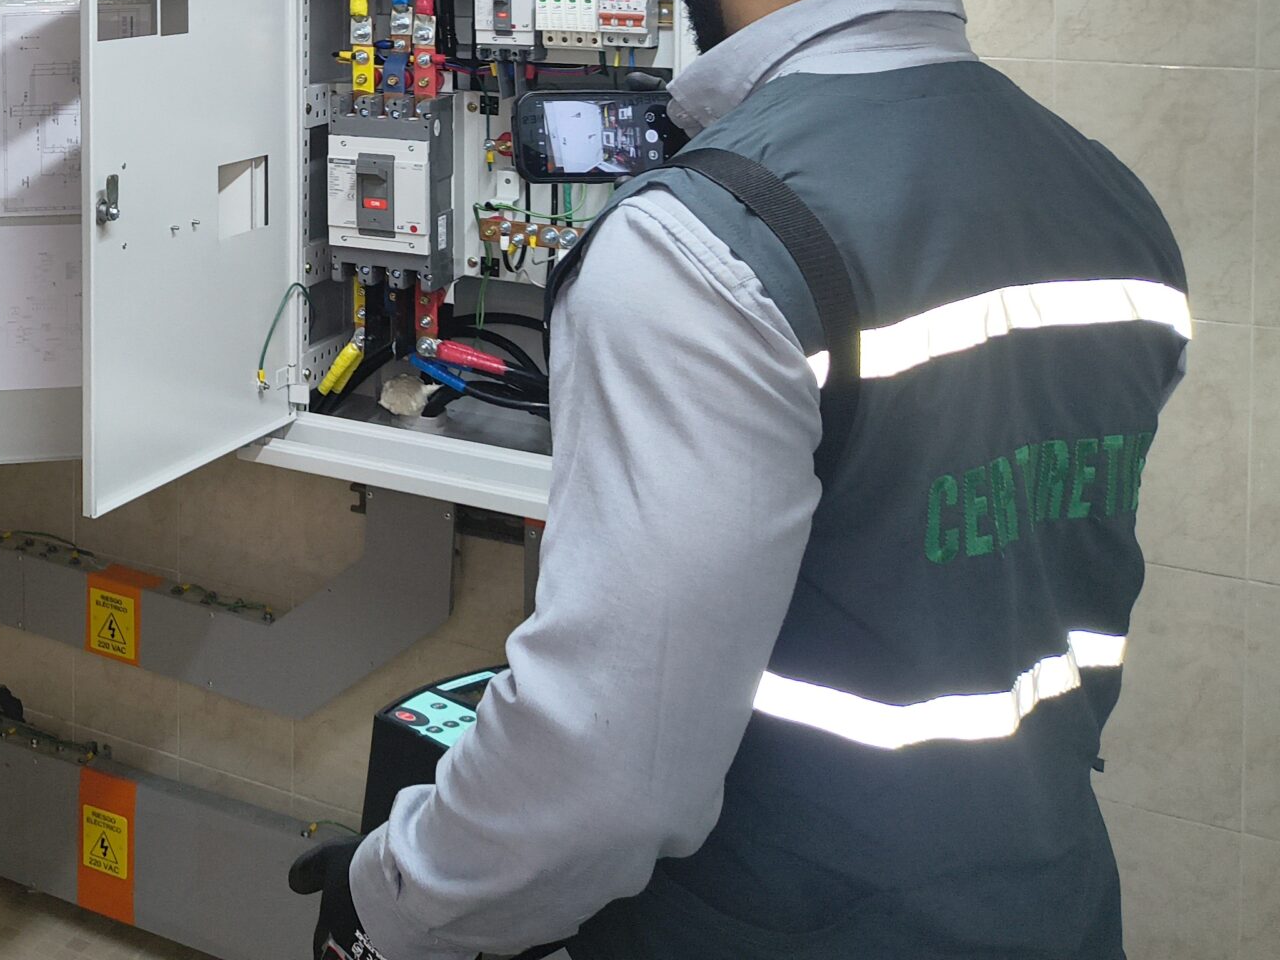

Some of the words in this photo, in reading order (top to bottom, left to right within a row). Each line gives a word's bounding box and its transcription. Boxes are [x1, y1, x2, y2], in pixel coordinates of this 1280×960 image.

[100, 594, 122, 605] RIESGO
[97, 640, 110, 650] 220
[112, 643, 126, 654] VAC
[88, 857, 102, 868] 220
[103, 862, 119, 874] VAC
